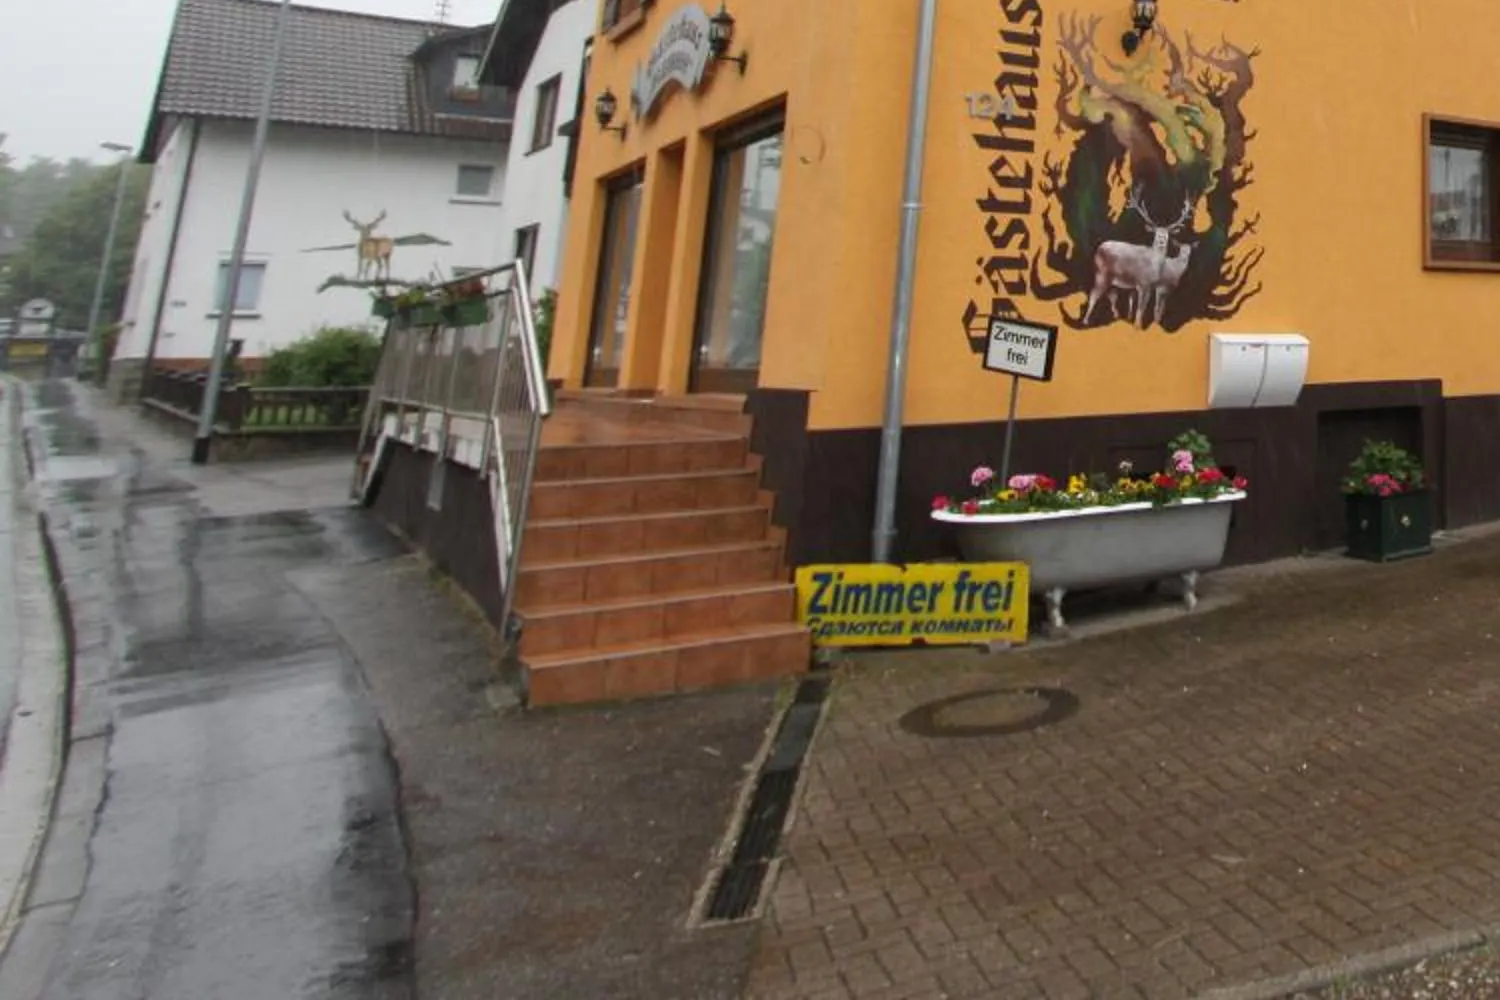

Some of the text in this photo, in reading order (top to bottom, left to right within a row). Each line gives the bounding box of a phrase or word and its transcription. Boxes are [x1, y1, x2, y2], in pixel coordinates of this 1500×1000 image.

[994, 325, 1046, 349] Zimmer
[1007, 348, 1029, 365] frei
[807, 569, 1016, 616] Zimmer frei
